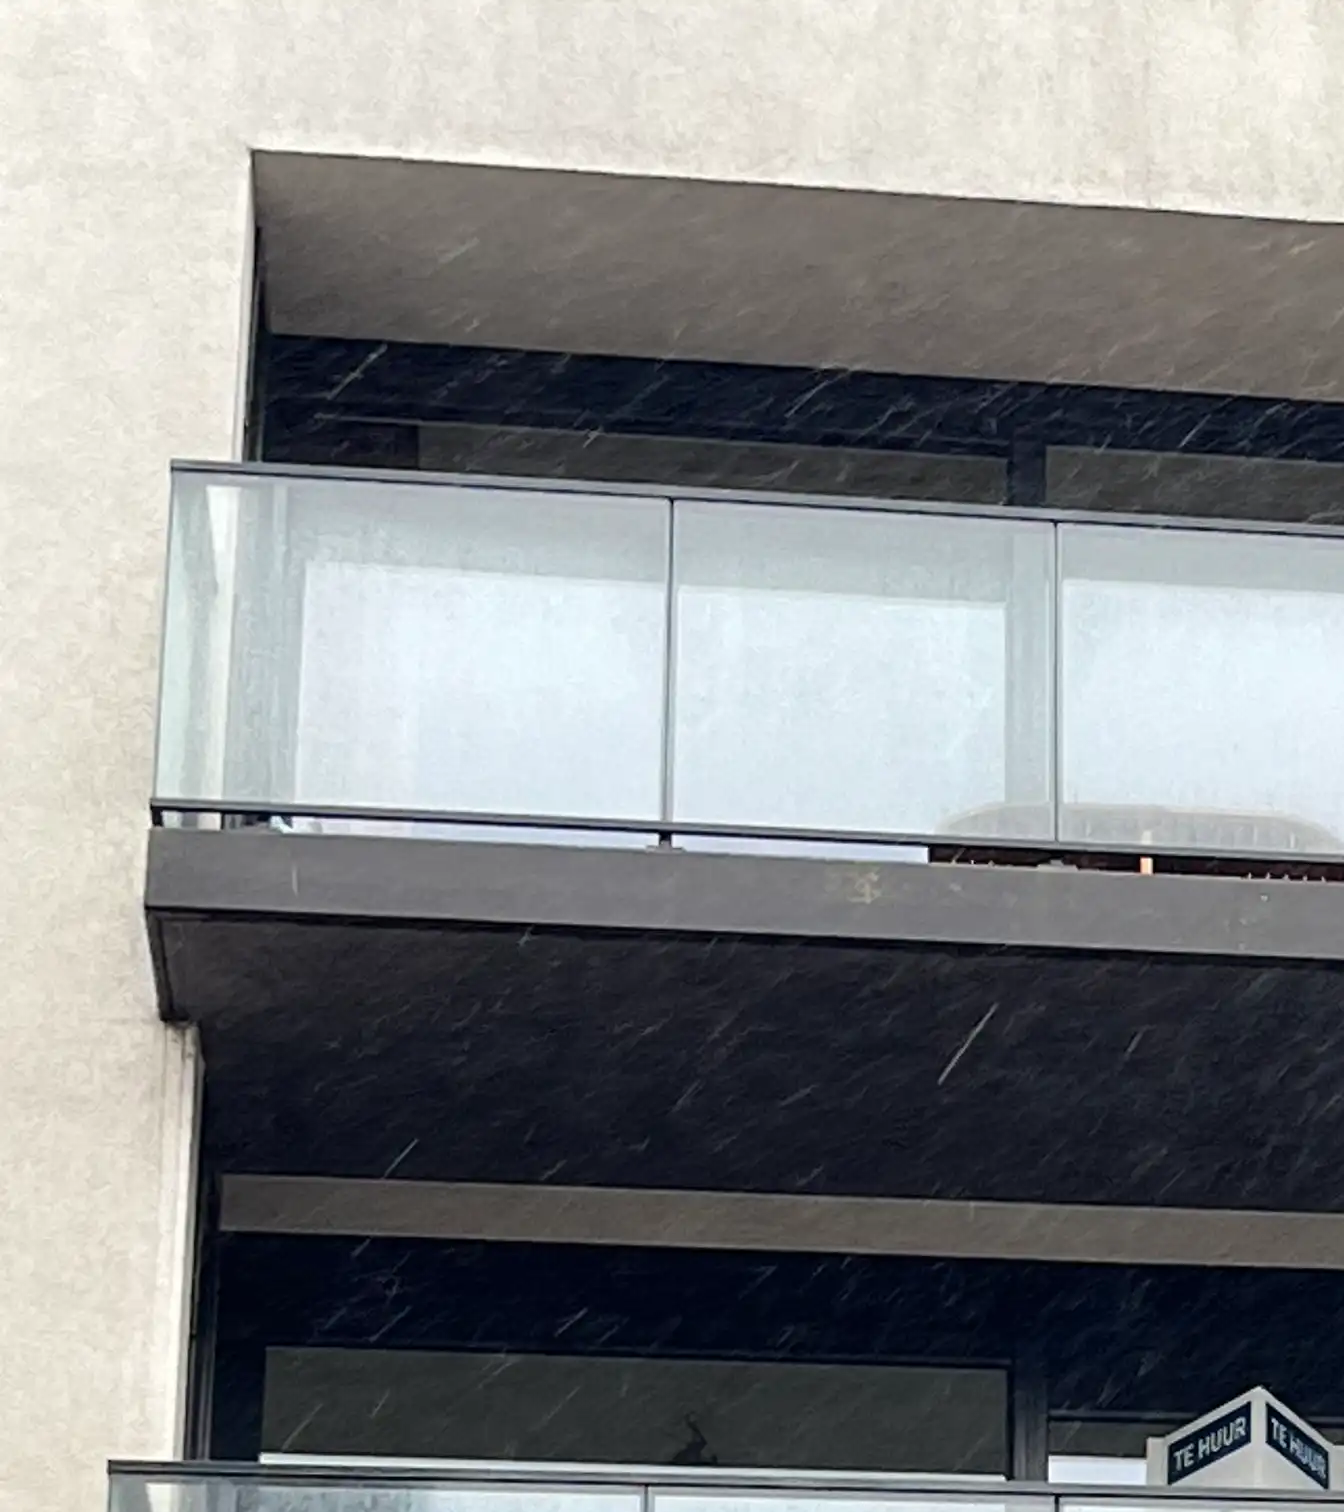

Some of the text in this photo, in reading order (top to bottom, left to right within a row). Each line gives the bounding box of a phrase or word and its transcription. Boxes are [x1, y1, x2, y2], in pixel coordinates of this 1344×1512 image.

[1173, 1416, 1247, 1471] TE HUUR
[1270, 1416, 1326, 1479] TE HUUR
